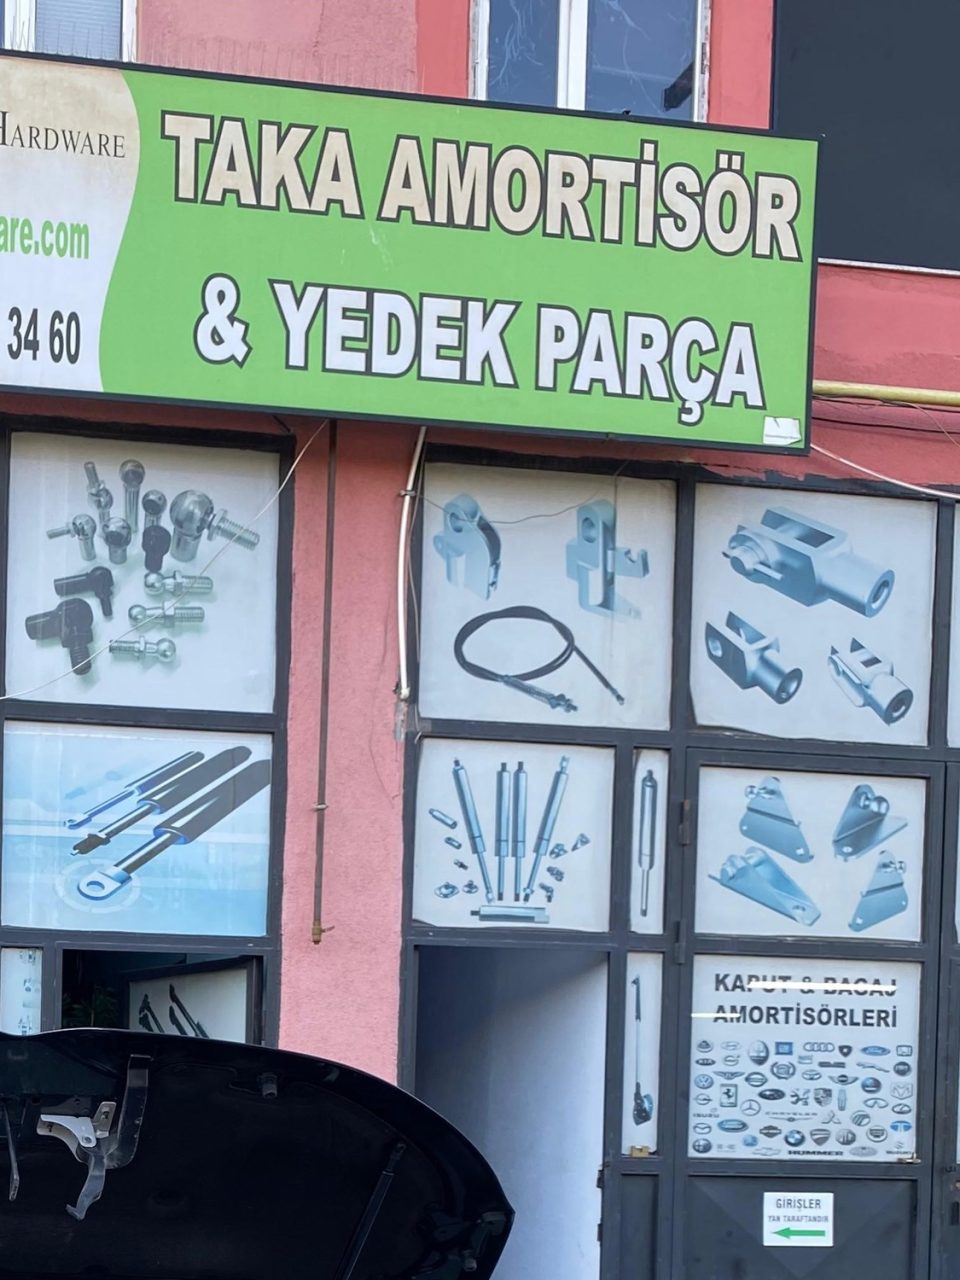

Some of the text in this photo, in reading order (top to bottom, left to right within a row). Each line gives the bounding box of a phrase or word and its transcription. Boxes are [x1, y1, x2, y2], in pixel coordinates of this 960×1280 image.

[160, 110, 803, 263] TAKA AMORTİSÖR
[7, 307, 39, 360] 34
[49, 311, 81, 364] 60
[193, 272, 767, 426] & YEDEK PARÇA
[712, 1003, 898, 1028] AMORTİSÖRLERİ
[776, 1196, 822, 1212] GİRİŞLER
